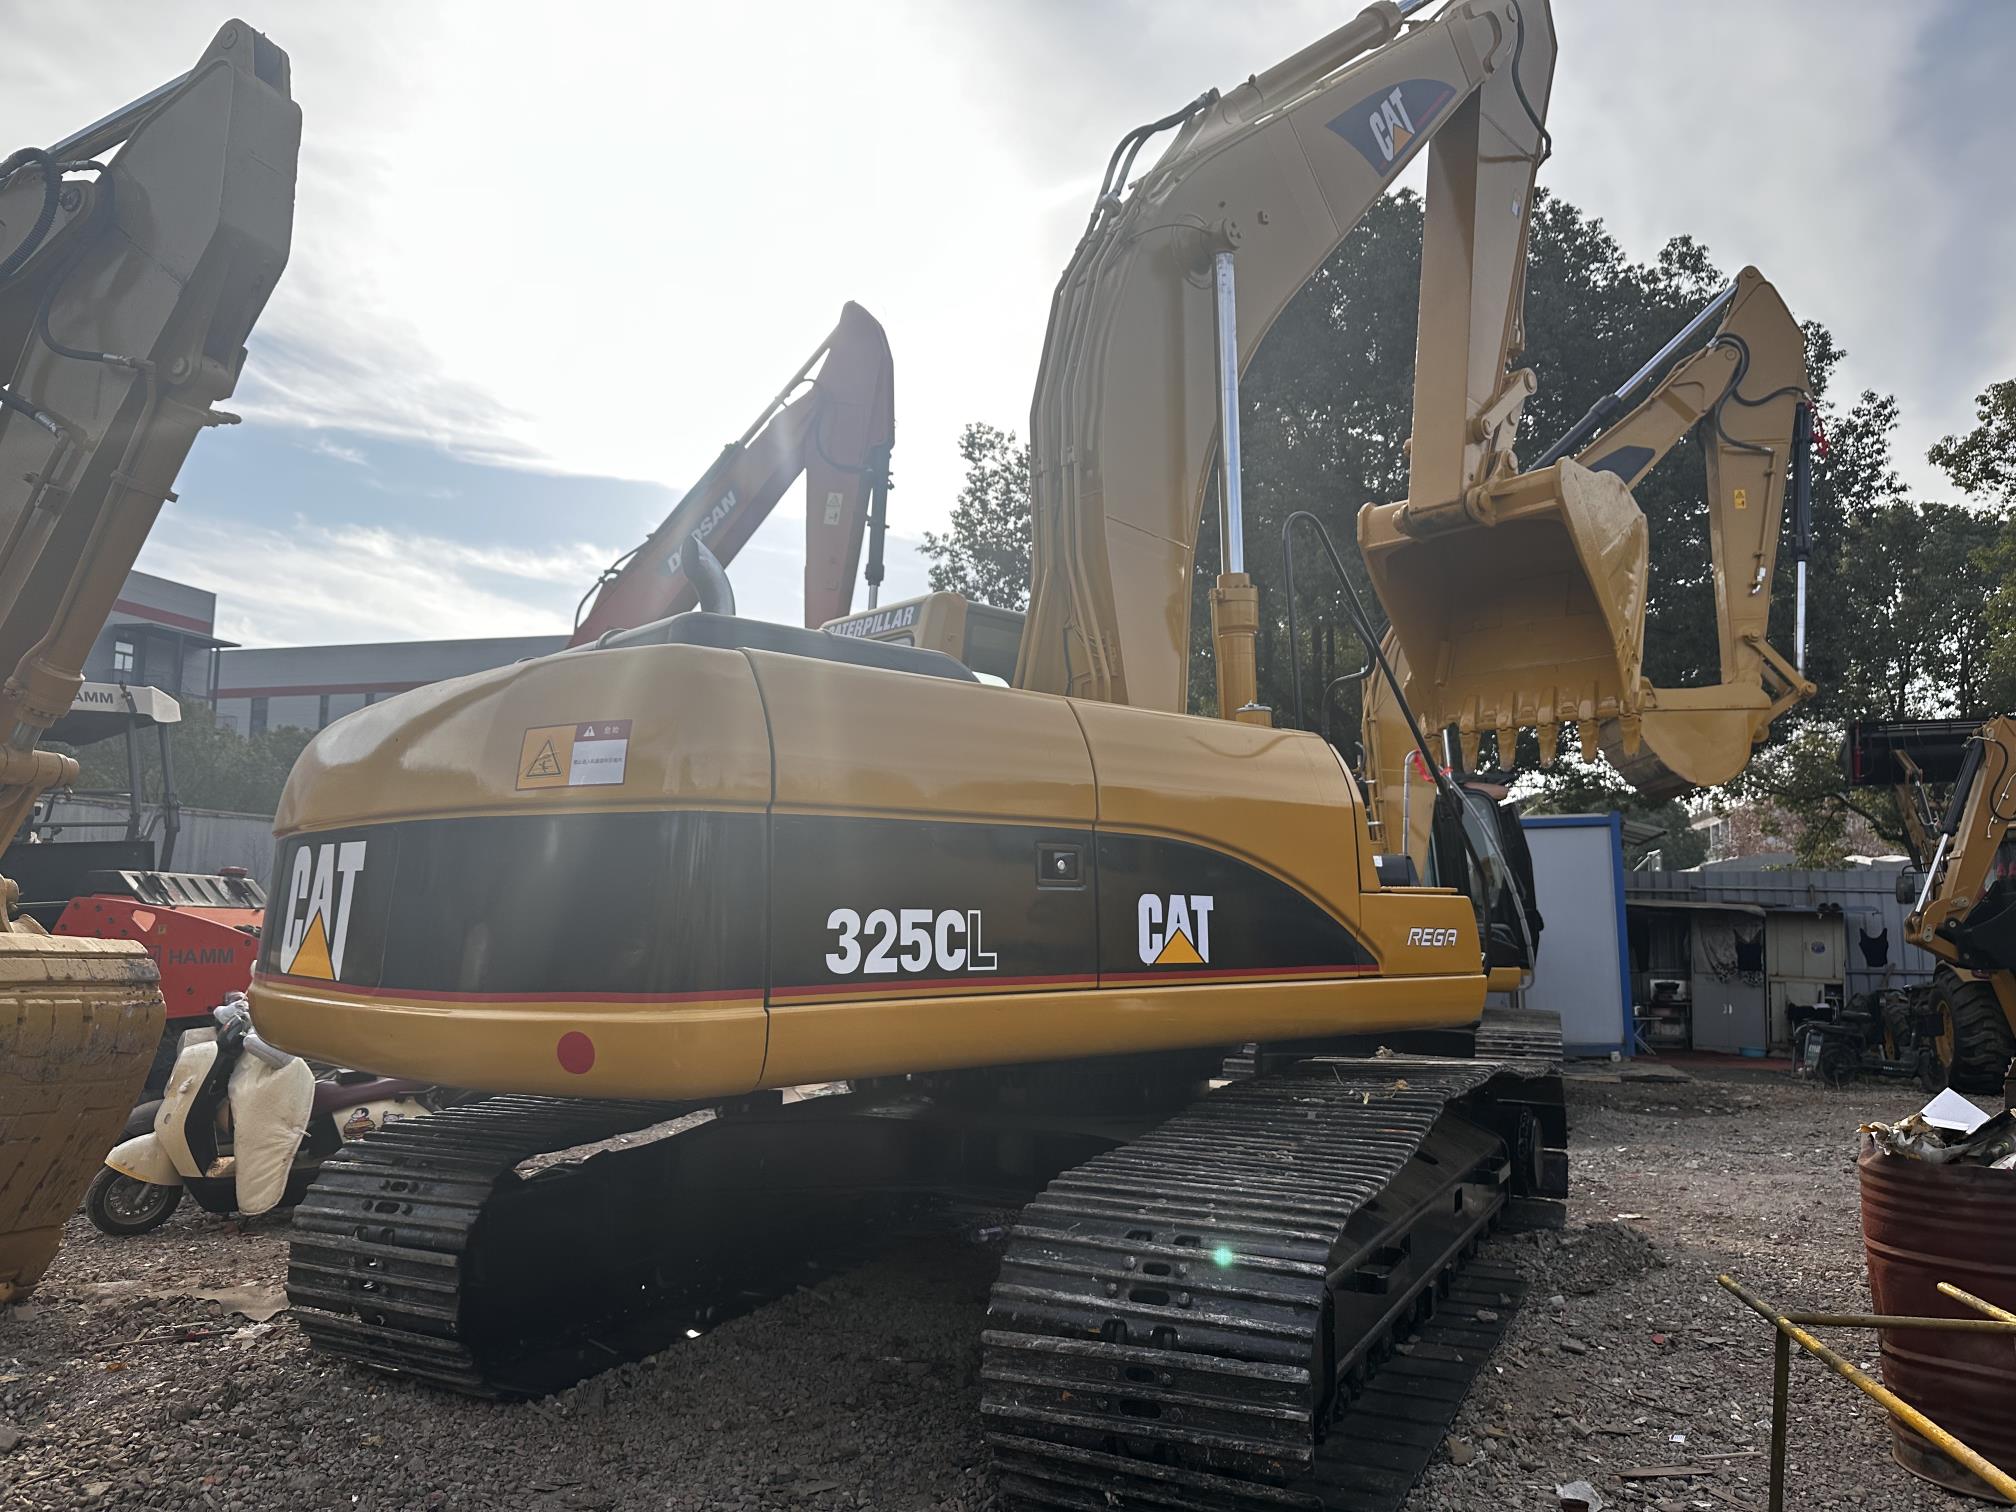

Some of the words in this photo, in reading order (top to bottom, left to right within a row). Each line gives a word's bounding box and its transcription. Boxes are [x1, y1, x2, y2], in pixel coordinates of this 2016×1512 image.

[1369, 86, 1415, 161] CAT
[280, 840, 367, 981] CAT
[825, 908, 998, 975] 325CL
[1138, 893, 1214, 965] CAT
[1407, 927, 1458, 948] REGA
[168, 947, 234, 964] HAMM
